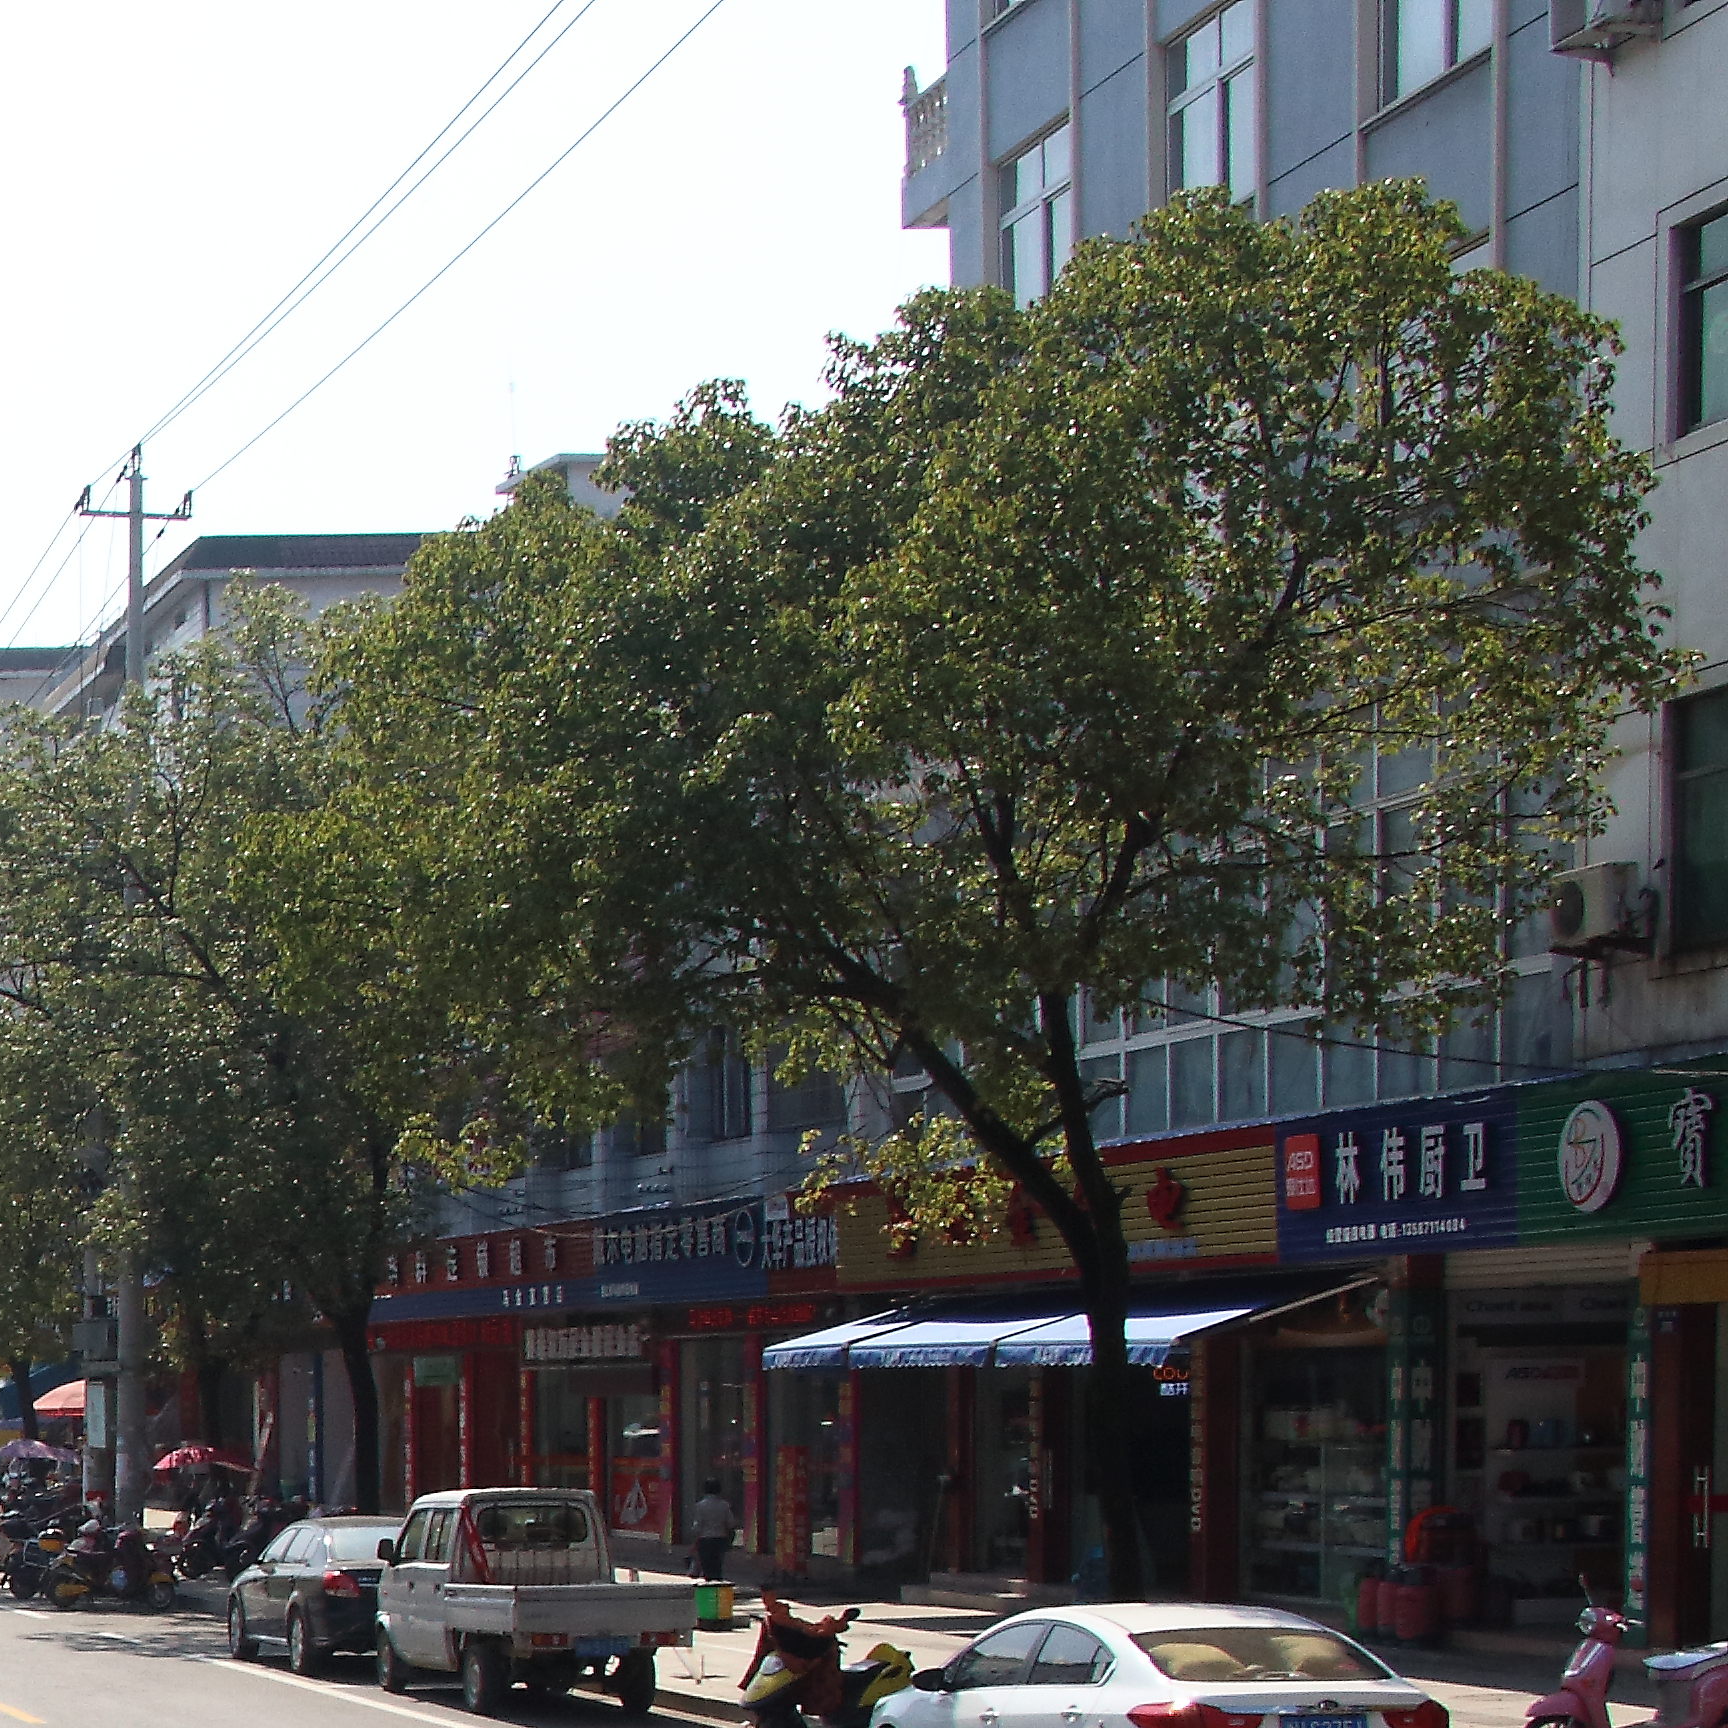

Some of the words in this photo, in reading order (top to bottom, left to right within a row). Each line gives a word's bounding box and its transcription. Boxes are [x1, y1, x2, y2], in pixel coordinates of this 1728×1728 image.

[1286, 1150, 1314, 1172] ASD
[1334, 1121, 1486, 1206] 林伟厨卫
